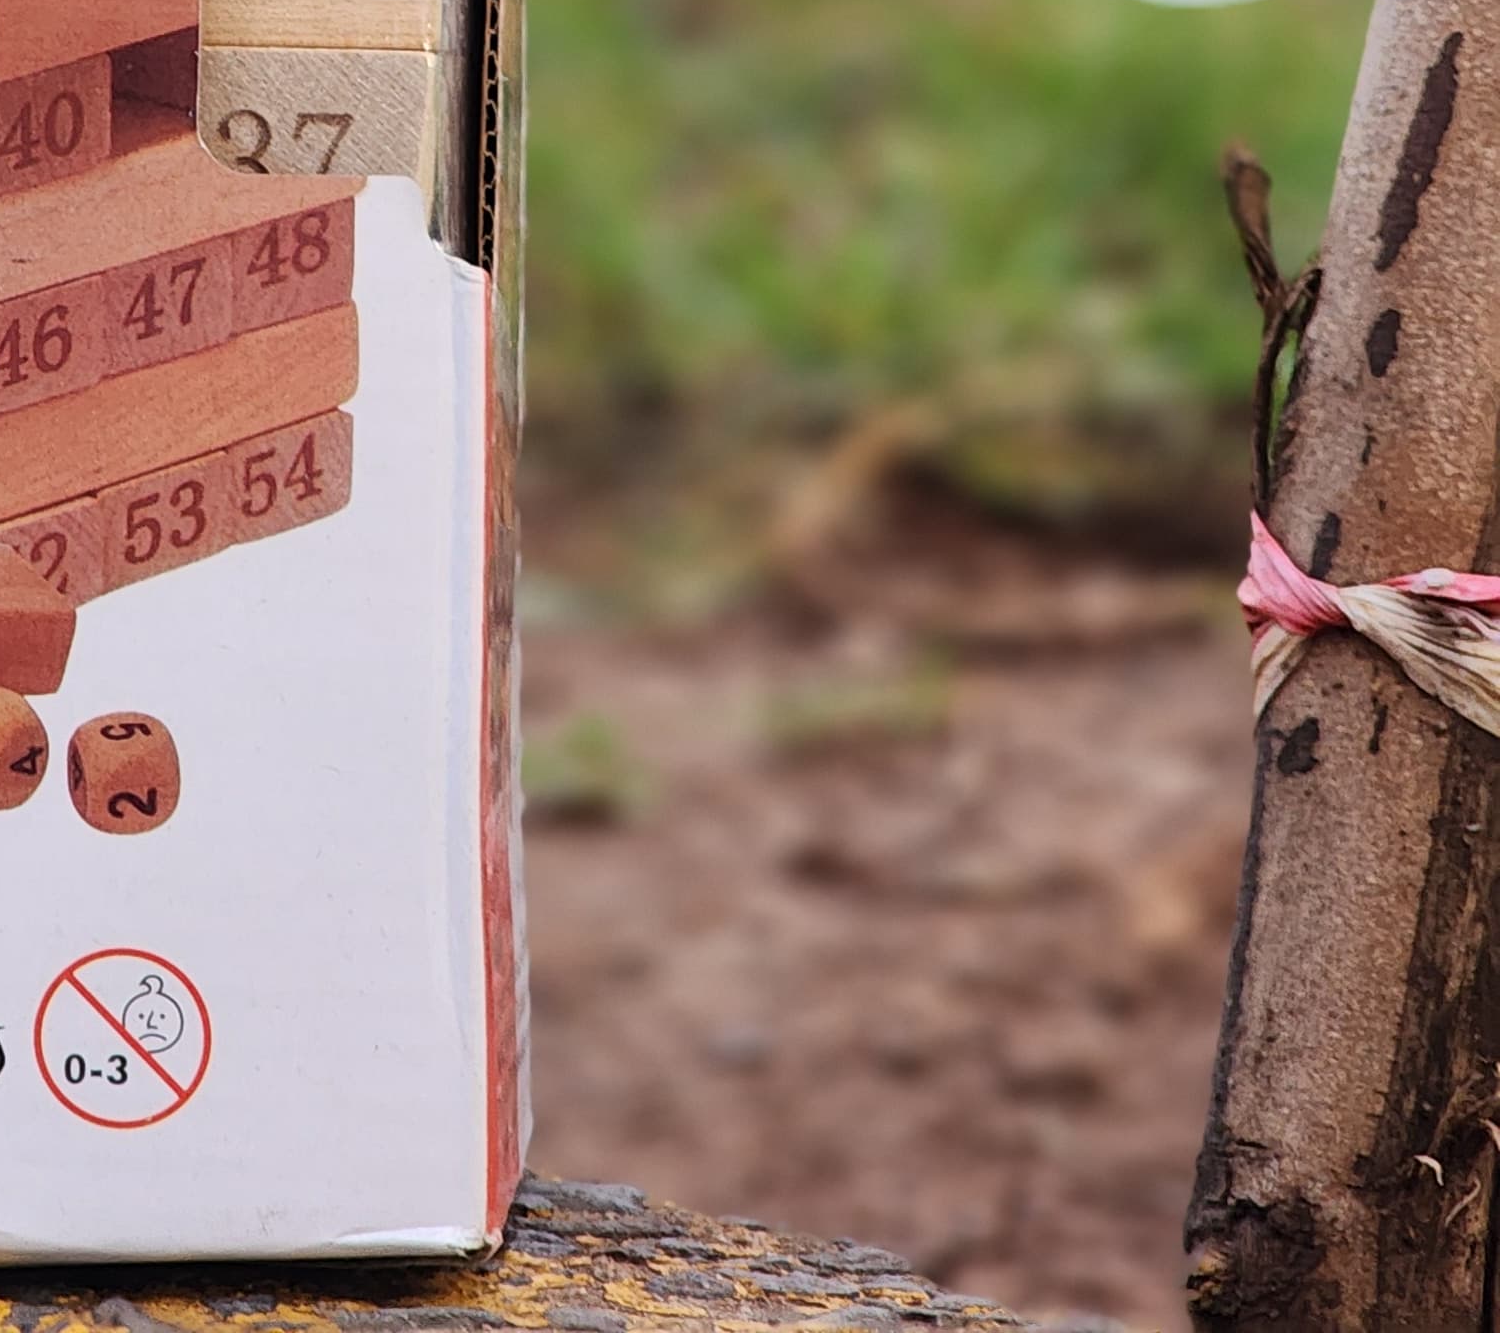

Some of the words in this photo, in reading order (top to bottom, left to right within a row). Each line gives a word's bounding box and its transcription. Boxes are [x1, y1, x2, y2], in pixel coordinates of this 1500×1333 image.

[121, 257, 207, 338] 47
[245, 209, 329, 287] 48
[13, 532, 70, 594] 2
[124, 480, 207, 564] 53
[241, 432, 325, 518] 54
[108, 787, 158, 819] 2
[63, 1054, 129, 1085] 0-3
